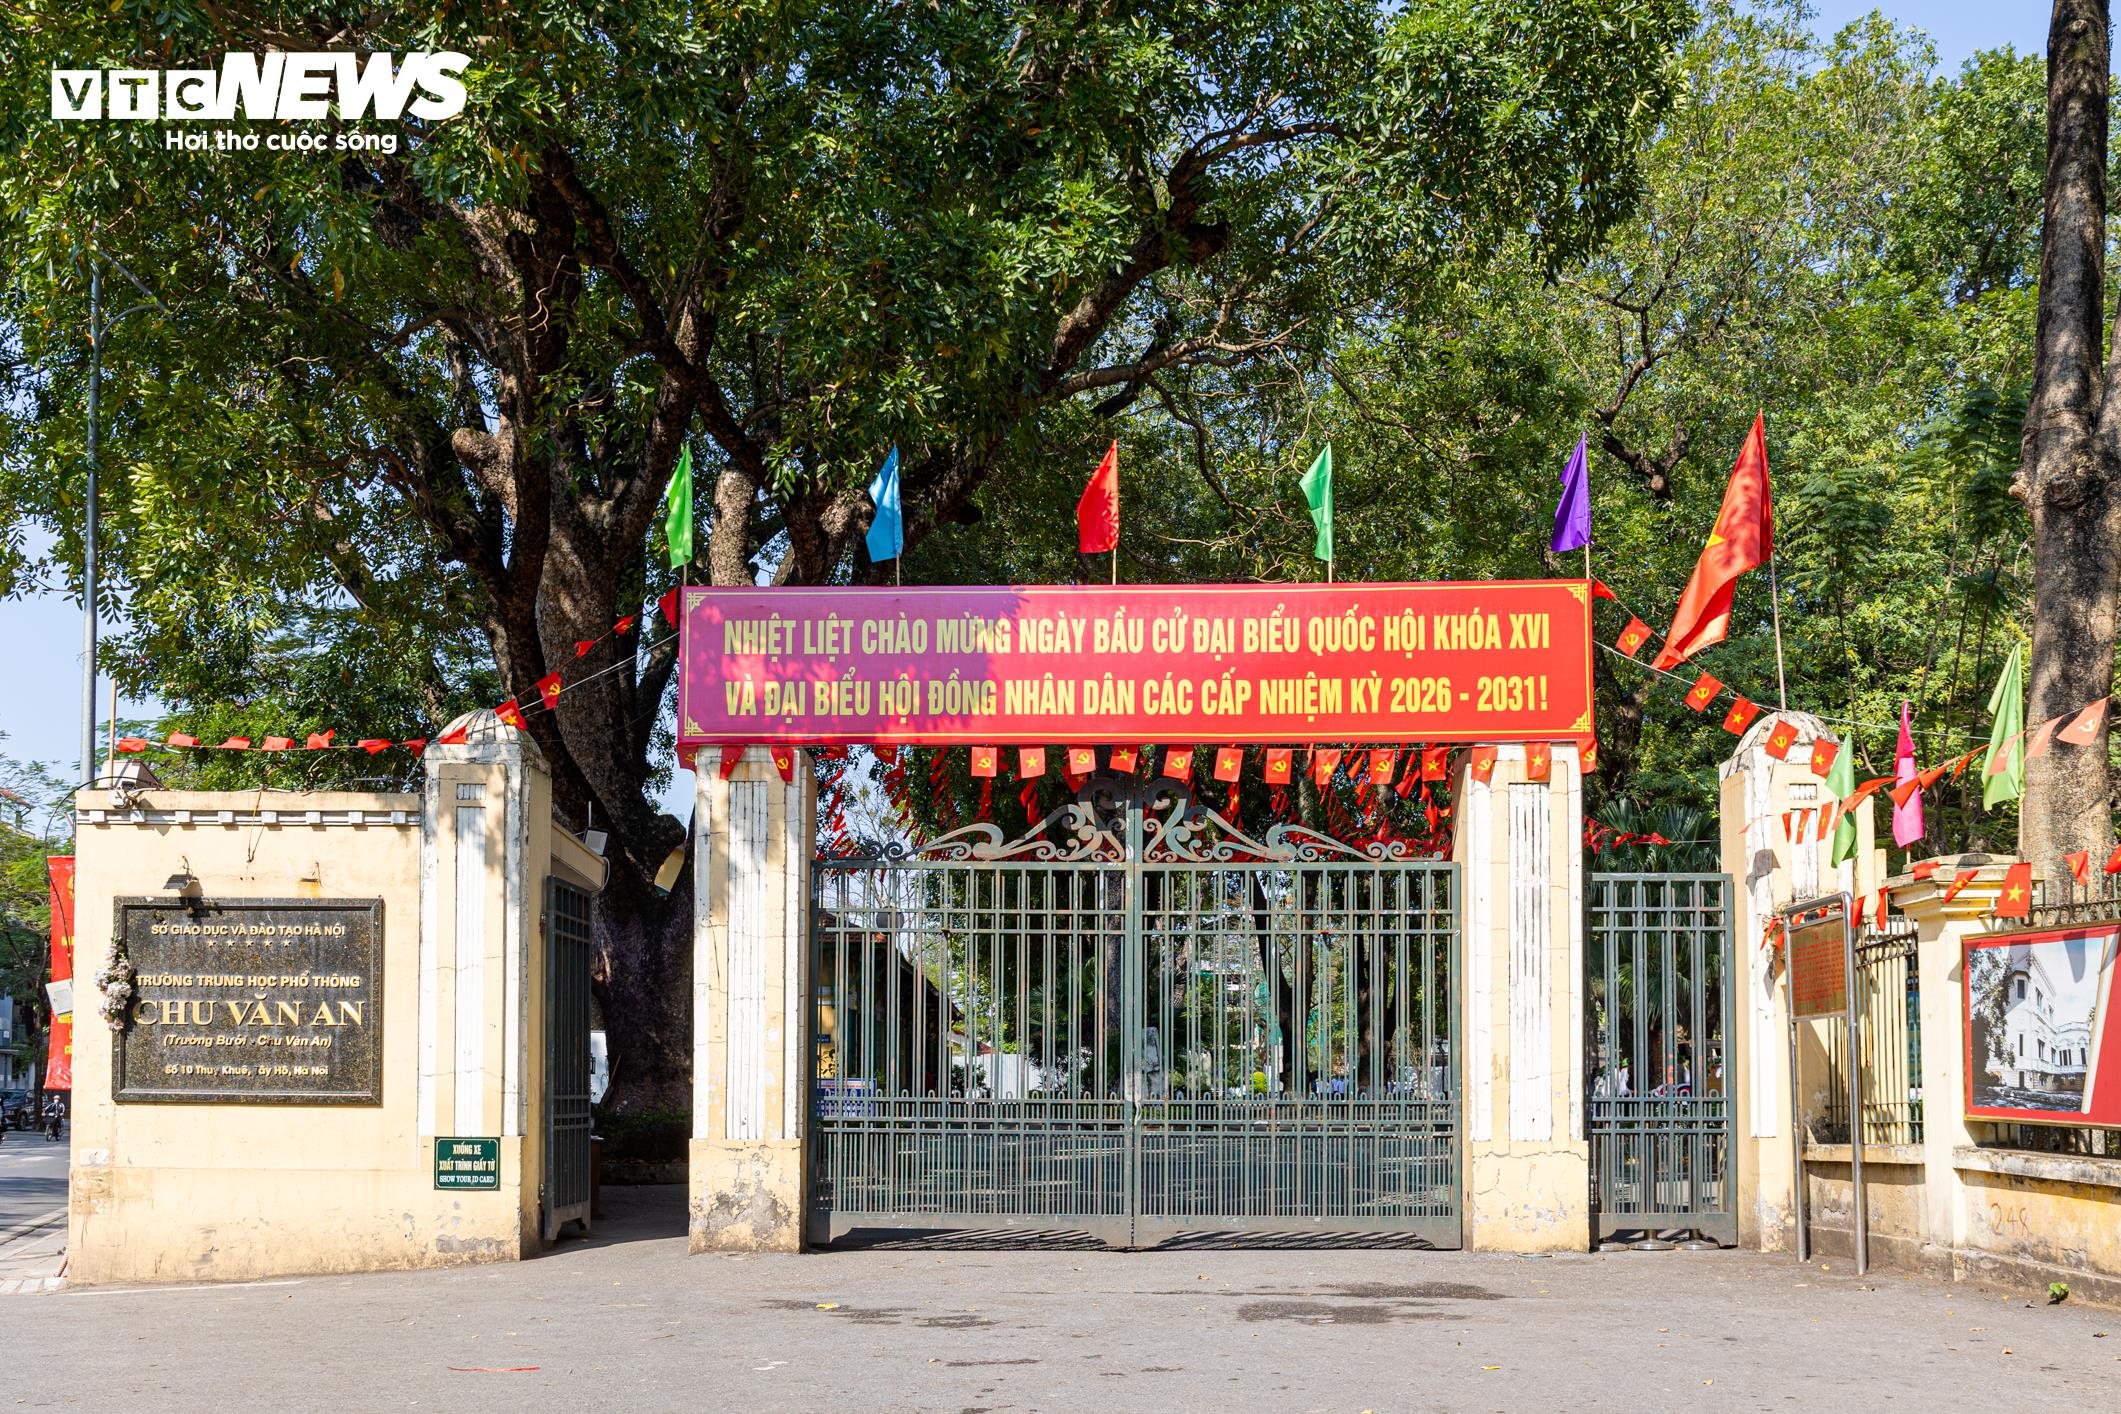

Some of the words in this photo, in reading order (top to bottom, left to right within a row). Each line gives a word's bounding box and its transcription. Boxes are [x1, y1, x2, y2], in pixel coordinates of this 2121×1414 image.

[724, 612, 796, 663] NHIỆT
[803, 612, 854, 663] LIỆT
[861, 611, 928, 655] CHÀO
[936, 611, 1011, 655] MỪNG
[1019, 611, 1086, 654] NGÀY
[1094, 606, 1144, 654] BẦU
[1152, 606, 1188, 654] CỬ
[1192, 617, 1235, 662] ĐẠI
[1243, 603, 1300, 654] BIỂU
[1308, 603, 1376, 657] QUỐC
[1384, 607, 1425, 659] HỘI
[1433, 606, 1502, 651] KHÓA
[1508, 612, 1550, 650] XVI
[724, 673, 757, 716] VÀ
[764, 680, 806, 724] ĐẠI
[813, 666, 871, 716] BIỂU
[878, 672, 920, 724] HỘI
[928, 667, 997, 716] ĐỒNG
[1004, 672, 1075, 715] NHÂN
[1082, 672, 1135, 715] DÂN
[1142, 671, 1194, 715] CÁC
[1201, 666, 1252, 715] CẤP
[1259, 671, 1342, 723] NHIỆM
[1350, 670, 1383, 714] KỲ
[1390, 676, 1452, 714] 2026
[1476, 675, 1548, 712] 2031!
[203, 925, 228, 938] DỤC
[231, 922, 247, 935] VÀ
[249, 922, 276, 936] ĐÀO
[278, 925, 303, 938] TẠO
[324, 922, 346, 939] NỘI
[135, 972, 193, 987] TRƯỜNG
[196, 974, 244, 987] TRUNG
[247, 974, 277, 991] HỌC
[311, 973, 361, 988] THÔNG
[131, 999, 217, 1026] CHU
[226, 993, 303, 1026] VĂN
[310, 999, 366, 1026] AN
[181, 1065, 193, 1075] 10
[474, 1144, 481, 1154] XE
